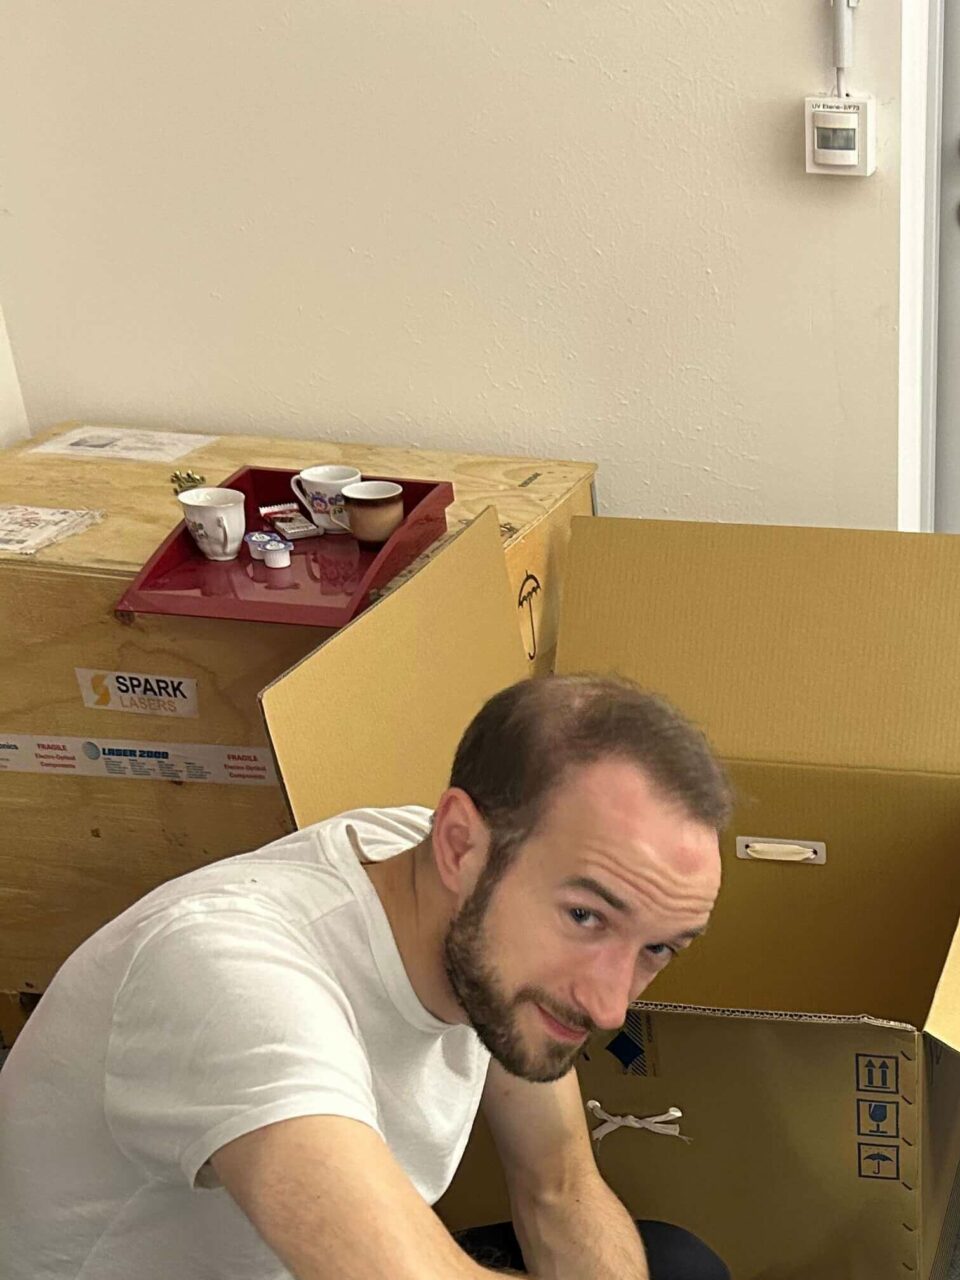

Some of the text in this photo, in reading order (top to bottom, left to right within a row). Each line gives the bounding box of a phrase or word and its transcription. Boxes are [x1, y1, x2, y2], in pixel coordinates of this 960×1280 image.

[115, 675, 188, 699] SPARK
[119, 696, 177, 713] LASERS
[37, 743, 67, 751] FRAGILE
[102, 748, 169, 759] LASER 2000
[226, 753, 258, 762] FRAGILE
